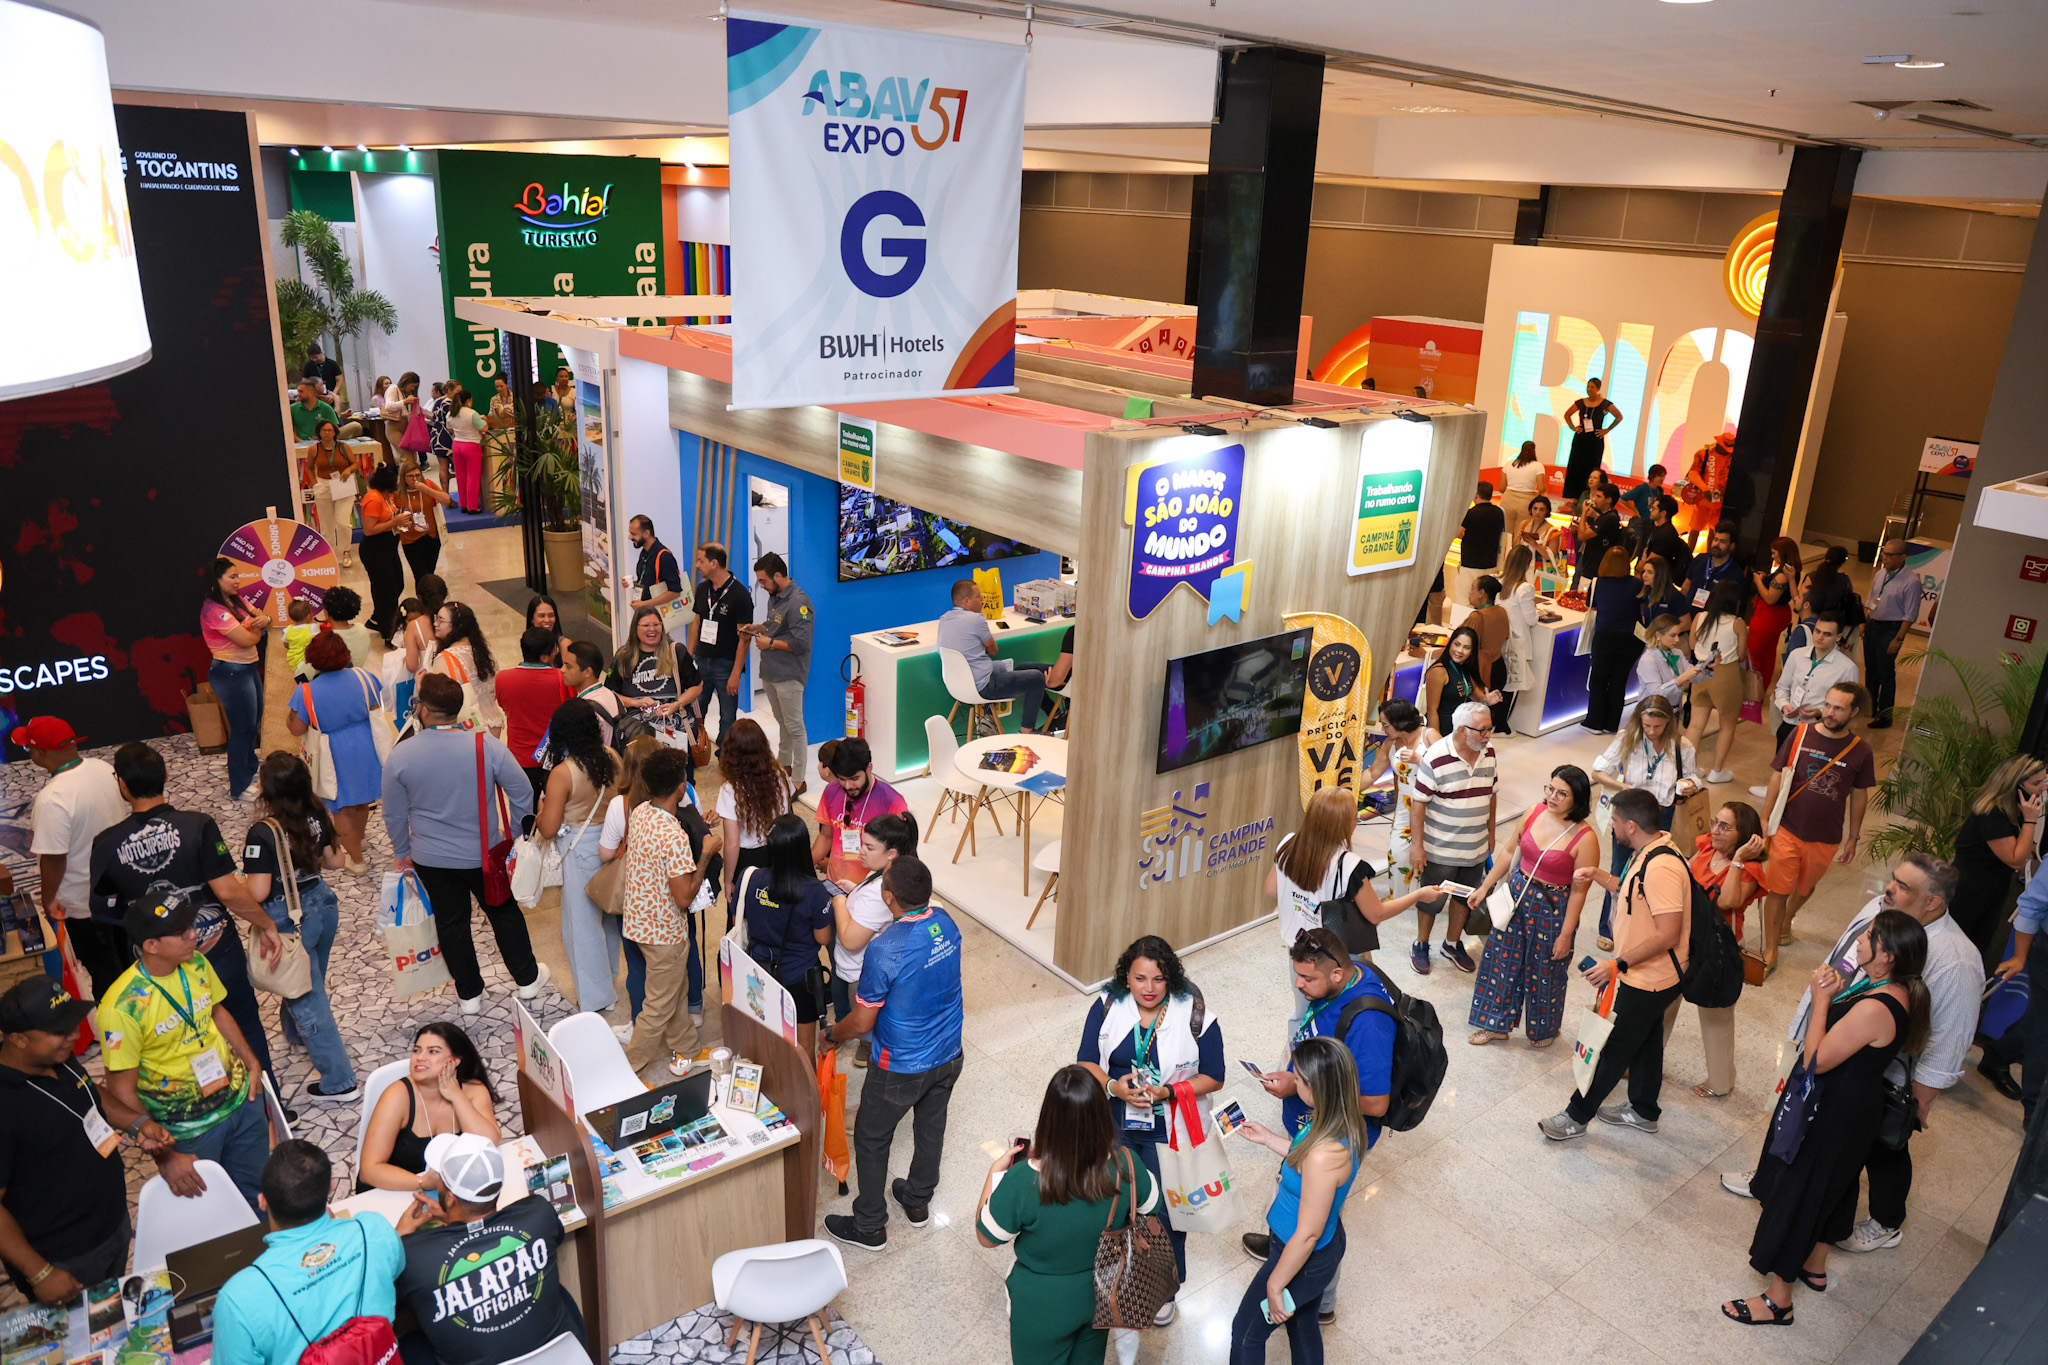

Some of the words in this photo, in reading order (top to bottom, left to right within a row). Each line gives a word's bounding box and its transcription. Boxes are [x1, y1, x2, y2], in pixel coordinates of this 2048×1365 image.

[801, 69, 930, 123] ABAV
[911, 87, 968, 151] 51
[823, 122, 905, 157] EXPO
[135, 151, 166, 159] GOVERNO
[135, 159, 239, 180] TOCANTINS
[524, 229, 600, 248] TURISMO
[840, 190, 927, 298] G
[820, 333, 878, 360] BWH
[890, 335, 944, 354] Hotels
[844, 369, 923, 381] Patrocinador
[1499, 311, 1755, 486] RIO
[842, 430, 868, 443] Trabalhando
[1928, 444, 1951, 453] ABAV
[842, 460, 860, 470] CAMPINA
[844, 467, 861, 477] GRANDE
[1155, 477, 1170, 497] O
[1172, 469, 1227, 492] MAIOR
[1366, 481, 1413, 497] Trabalhando
[1144, 497, 1183, 528] SÃO
[1185, 490, 1233, 518] JOÃO
[1364, 499, 1376, 509] no
[1376, 497, 1396, 508] rumo
[1396, 494, 1416, 505] certo
[1178, 517, 1198, 533] DO
[235, 536, 246, 546] NÃO
[245, 541, 255, 551] FOI
[268, 524, 282, 556] BRINDE
[1144, 523, 1227, 561] MUNDO
[1360, 531, 1395, 544] CAMPINA
[1362, 541, 1393, 555] GRANDE
[230, 541, 245, 554] DESSA
[245, 550, 256, 559] VEZ
[301, 567, 336, 577] BRINDE
[1145, 562, 1187, 577] CAMPINA
[1188, 554, 1225, 573] GRANDE
[275, 591, 288, 622] BRINDE
[1326, 731, 1343, 740] DO
[1209, 816, 1274, 850] CAMPINA
[116, 829, 181, 865] MOTOJIPEIROS
[1207, 835, 1267, 868] GRANDE
[1206, 867, 1220, 878] City
[1228, 859, 1248, 870] Media
[1248, 854, 1261, 864] Arts
[447, 1231, 480, 1257] JALAPÃO
[483, 1225, 515, 1235] OFICIAL
[315, 1256, 342, 1274] JALAPÃO
[432, 1237, 548, 1323] JALAPÃO
[472, 1281, 532, 1324] OFICIAL
[473, 1325, 499, 1333] EMOÇÃO
